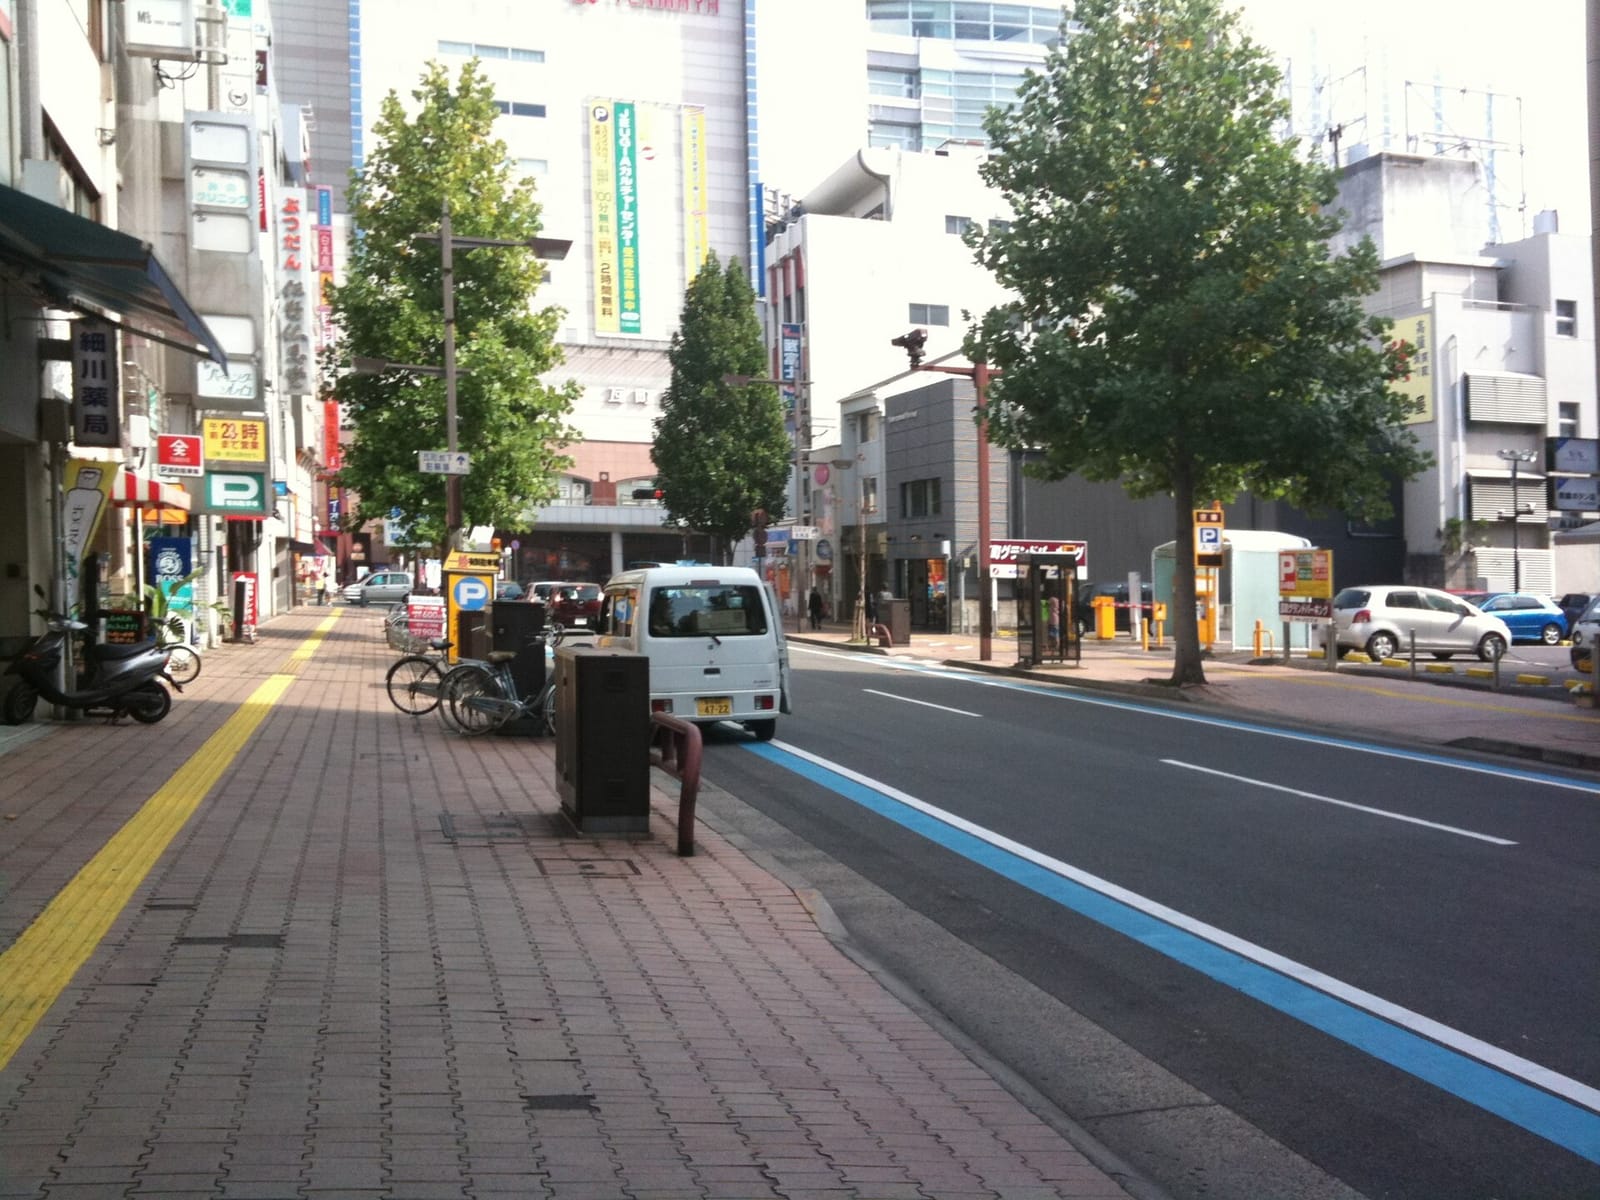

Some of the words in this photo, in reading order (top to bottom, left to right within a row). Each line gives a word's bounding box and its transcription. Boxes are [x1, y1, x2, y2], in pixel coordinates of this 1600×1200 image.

[80, 331, 109, 435] 細川薬局
[211, 474, 258, 506] P
[1202, 530, 1216, 542] P
[1280, 555, 1296, 582] P
[458, 582, 486, 605] P
[704, 705, 729, 714] 47-22
